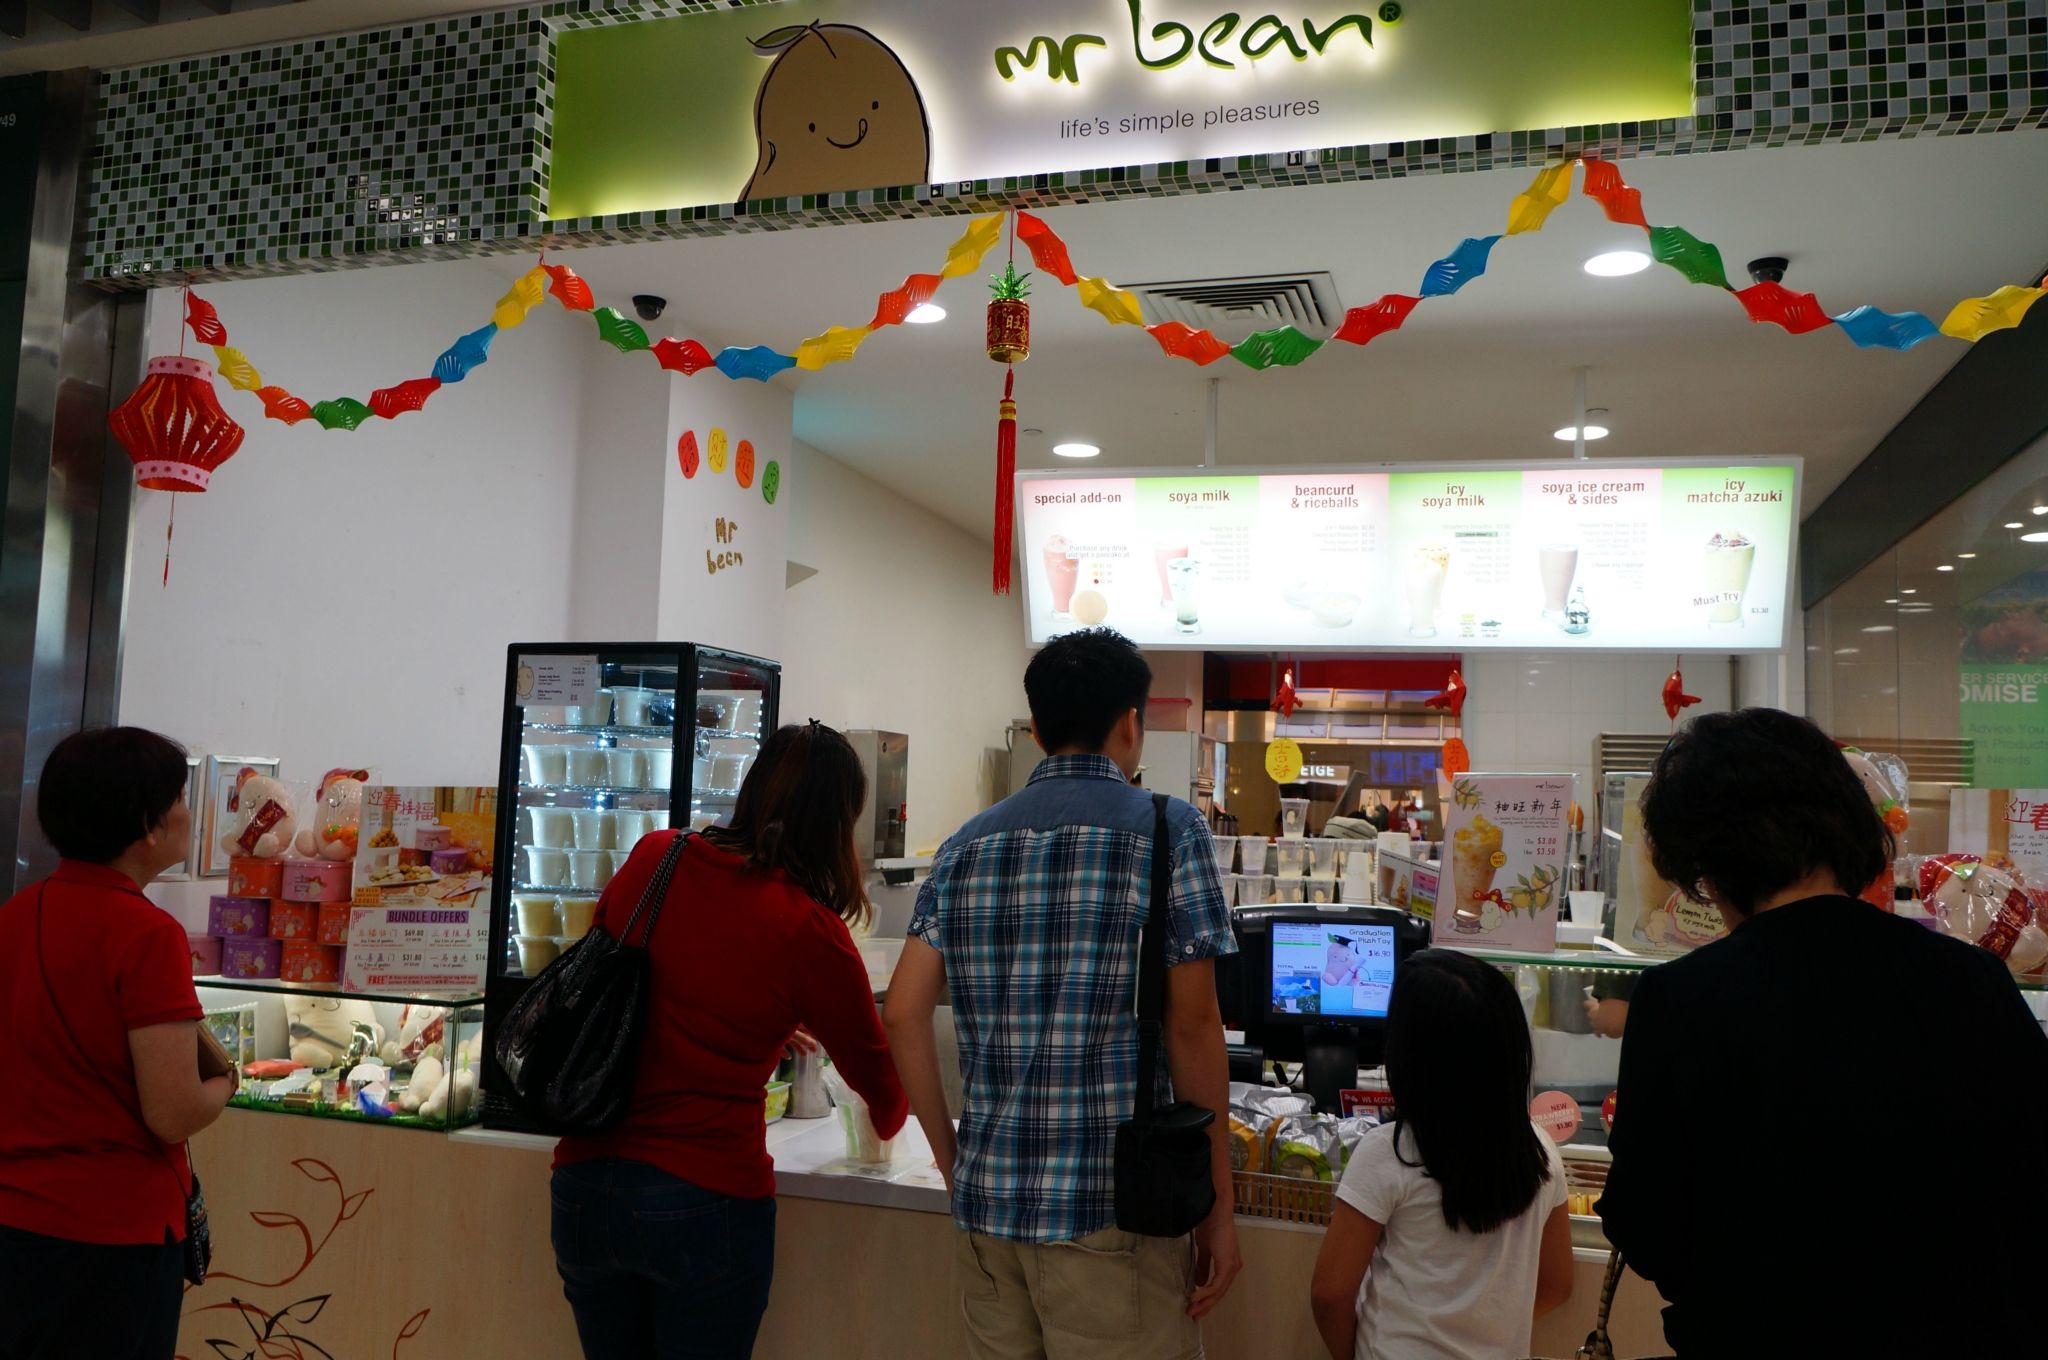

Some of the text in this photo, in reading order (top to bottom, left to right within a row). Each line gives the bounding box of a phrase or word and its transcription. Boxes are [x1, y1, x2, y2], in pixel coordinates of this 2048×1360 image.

[994, 0, 1375, 85] mr bean
[1060, 100, 1320, 139] life's simple pleasures
[1295, 484, 1355, 497] beancurd
[1446, 483, 1465, 497] icy
[1542, 480, 1646, 495] soya ice cream
[1725, 478, 1745, 493] icy
[1034, 491, 1122, 505] special add-on
[1169, 489, 1230, 504] soya milk
[1291, 496, 1359, 508] & riceballs
[1422, 494, 1485, 508] soya milk
[1568, 492, 1618, 505] & sides
[1687, 490, 1783, 503] matcha azuki
[715, 517, 738, 544] Mr
[1692, 590, 1740, 607] Must Try
[1750, 607, 1769, 615] $3.30
[367, 789, 435, 821] 迎春接福
[1537, 837, 1556, 845] $3.00
[388, 911, 466, 922] BUNDLE OFFERS
[1349, 929, 1391, 937] Graduation
[1357, 936, 1391, 945] Plush Toy
[1550, 1102, 1567, 1112] NEW
